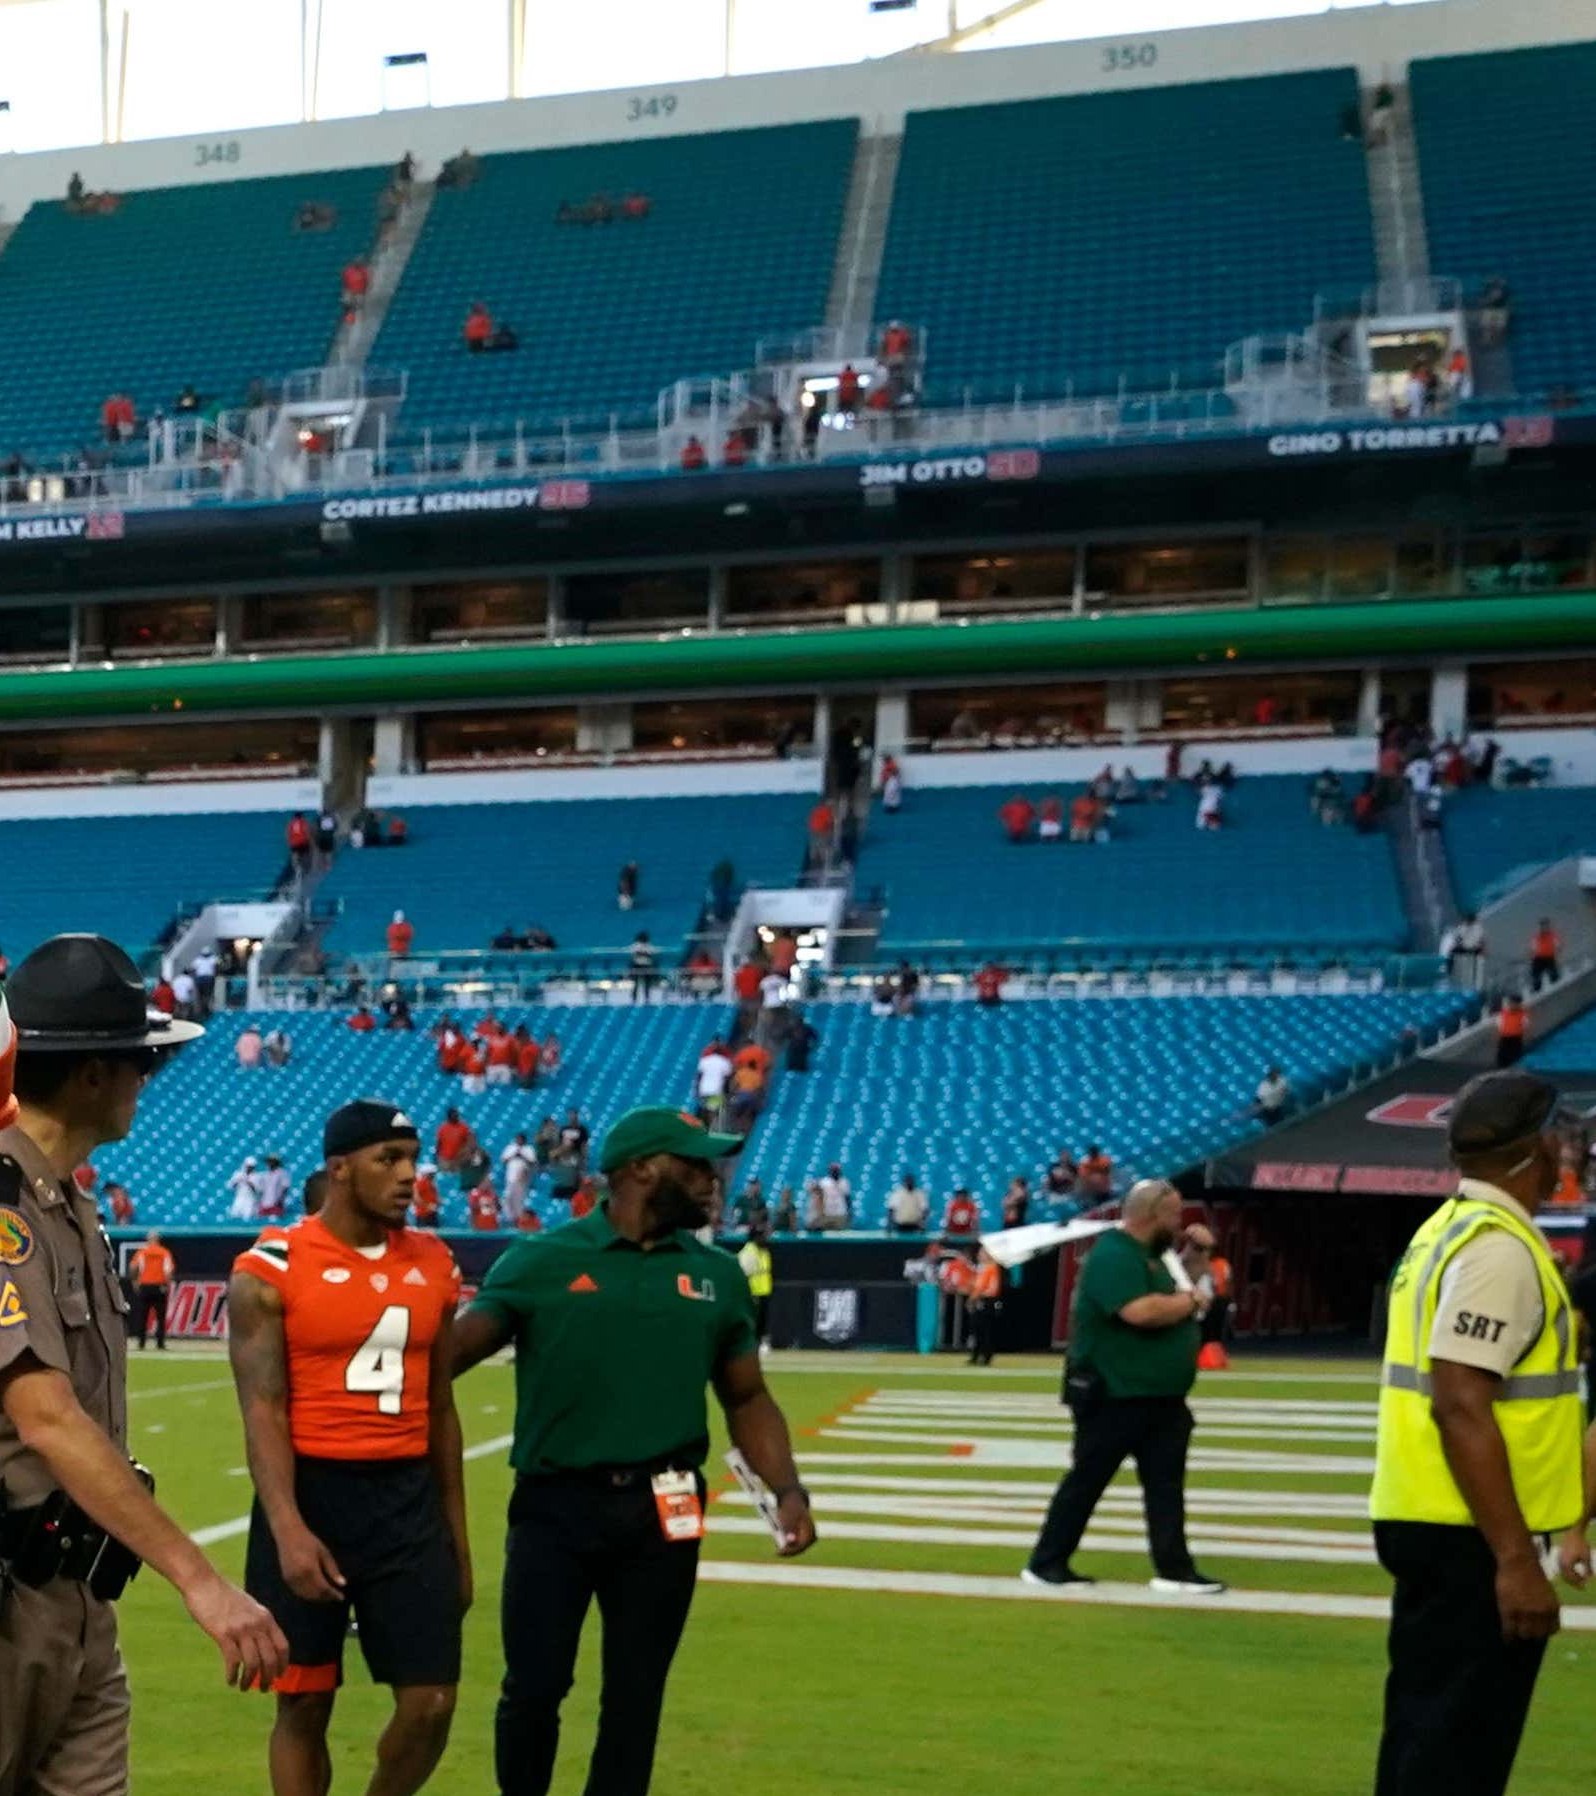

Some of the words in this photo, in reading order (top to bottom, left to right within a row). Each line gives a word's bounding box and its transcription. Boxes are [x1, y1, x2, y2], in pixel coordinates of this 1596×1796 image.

[1100, 43, 1157, 72] 350
[627, 95, 678, 121] 349
[194, 141, 240, 167] 348
[1268, 432, 1342, 456] GINO
[912, 455, 985, 482] OTTO
[16, 517, 85, 539] KELLY
[1453, 1311, 1509, 1343] SRT
[345, 1304, 410, 1415] 4
